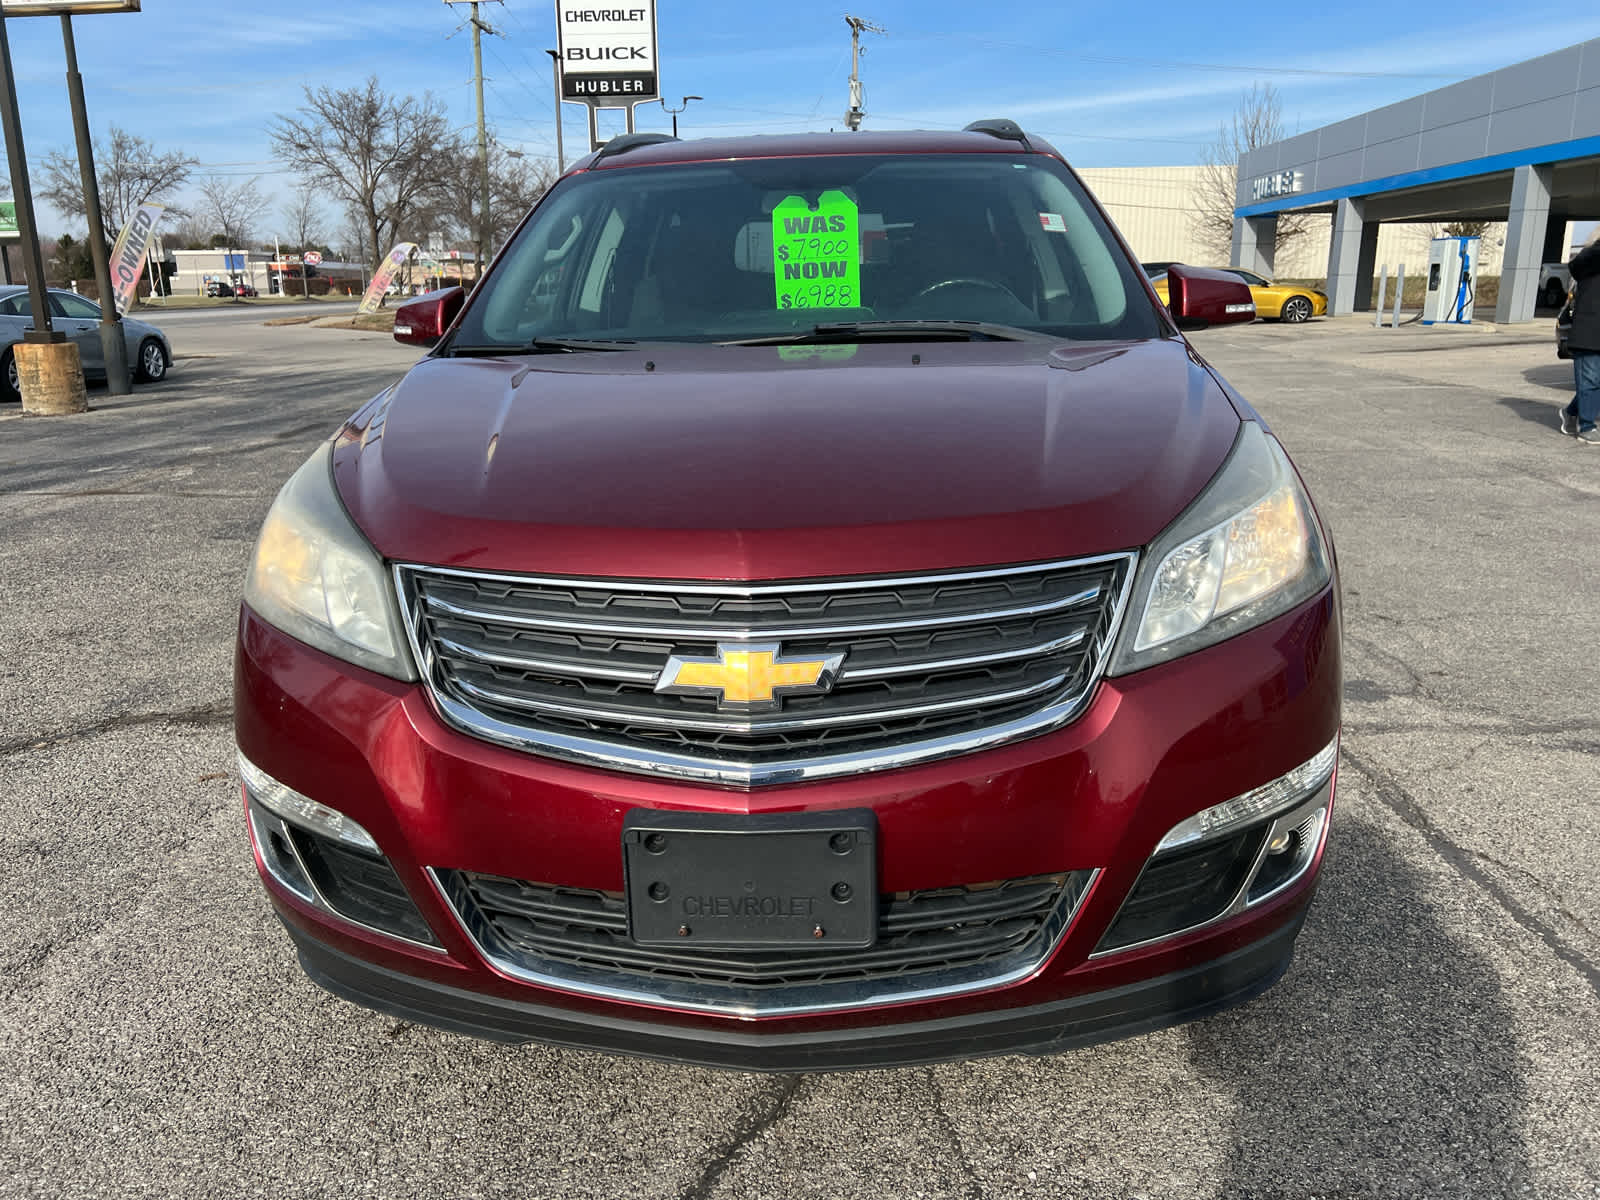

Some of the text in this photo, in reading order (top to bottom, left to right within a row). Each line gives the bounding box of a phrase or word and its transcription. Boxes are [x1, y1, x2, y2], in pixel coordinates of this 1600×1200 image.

[565, 9, 646, 22] CHEVROLET
[566, 46, 648, 60] BUICK
[575, 80, 644, 93] HUBLER
[783, 215, 846, 235] WAS
[784, 261, 848, 280] NOW
[682, 896, 817, 918] CHEVROLET
